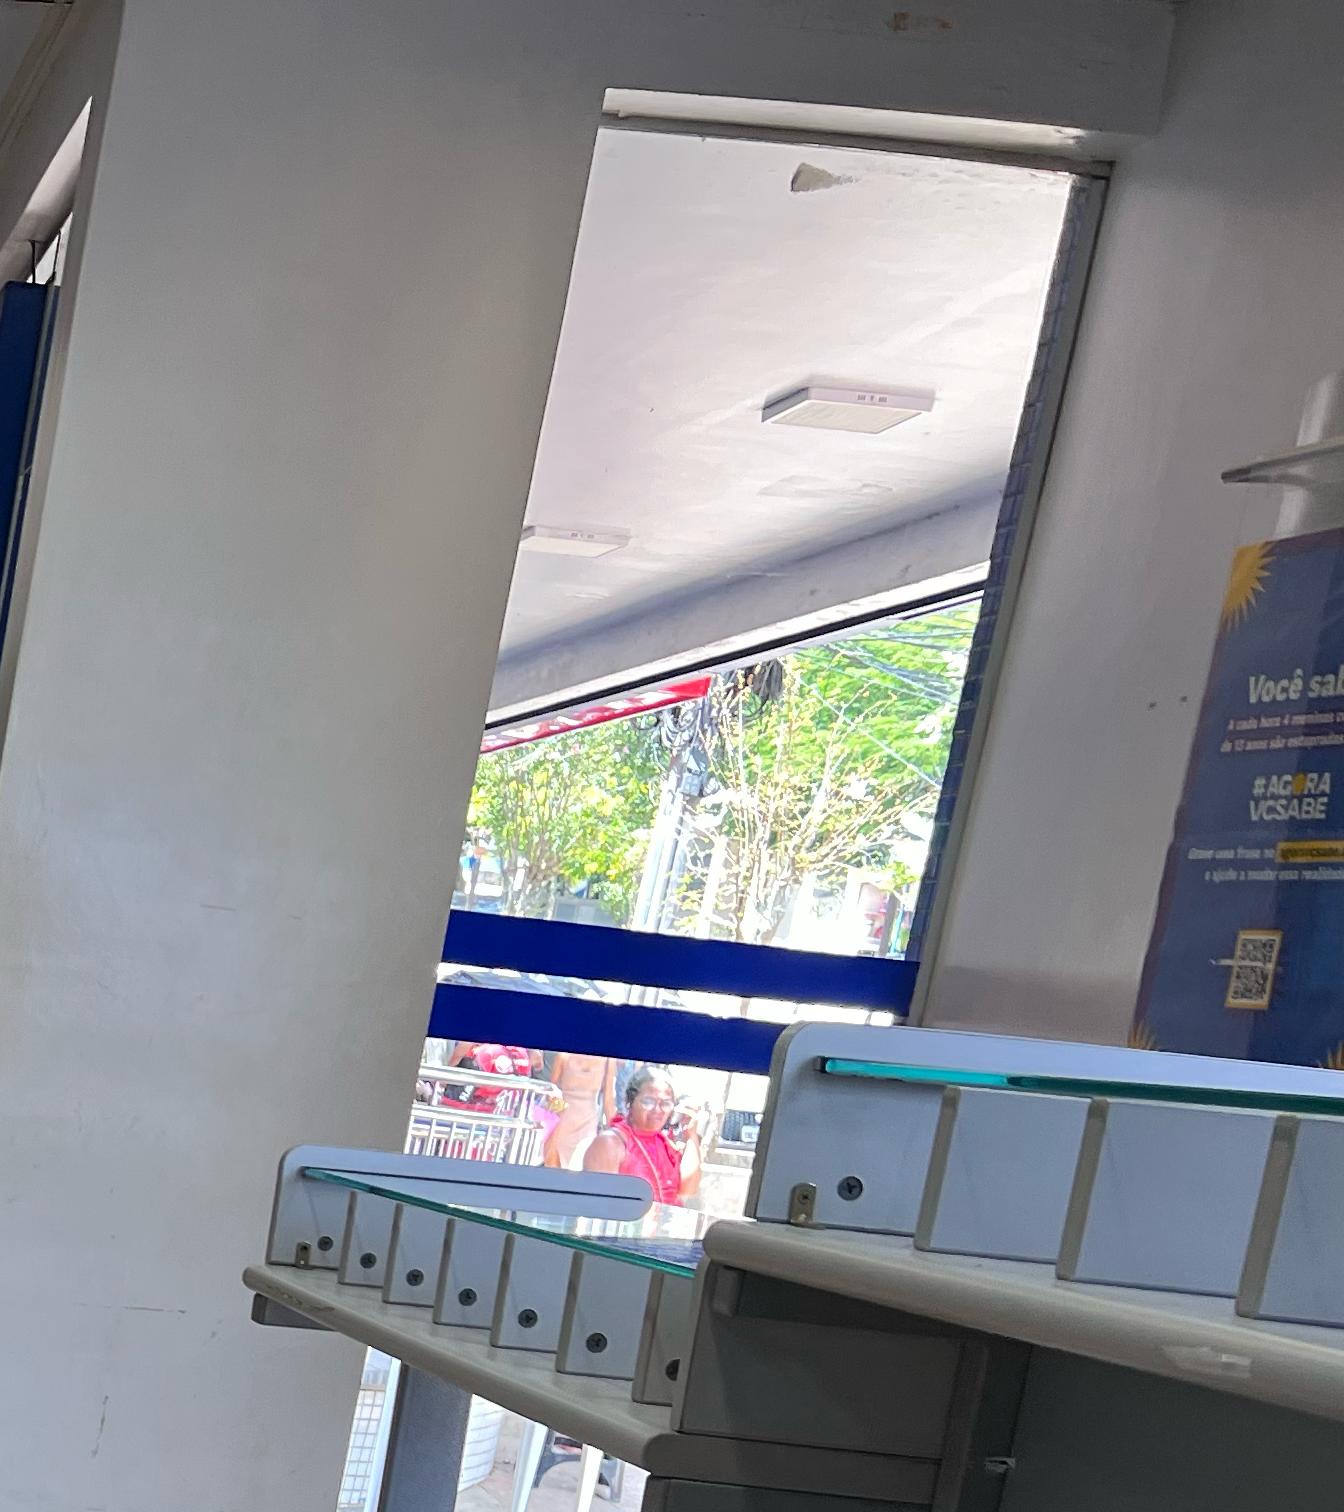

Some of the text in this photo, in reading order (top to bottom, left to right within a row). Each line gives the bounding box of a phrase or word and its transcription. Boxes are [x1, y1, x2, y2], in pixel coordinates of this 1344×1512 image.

[1249, 669, 1303, 703] Você
[1253, 772, 1331, 797] #AGORA
[1249, 798, 1328, 821] VCSABE
